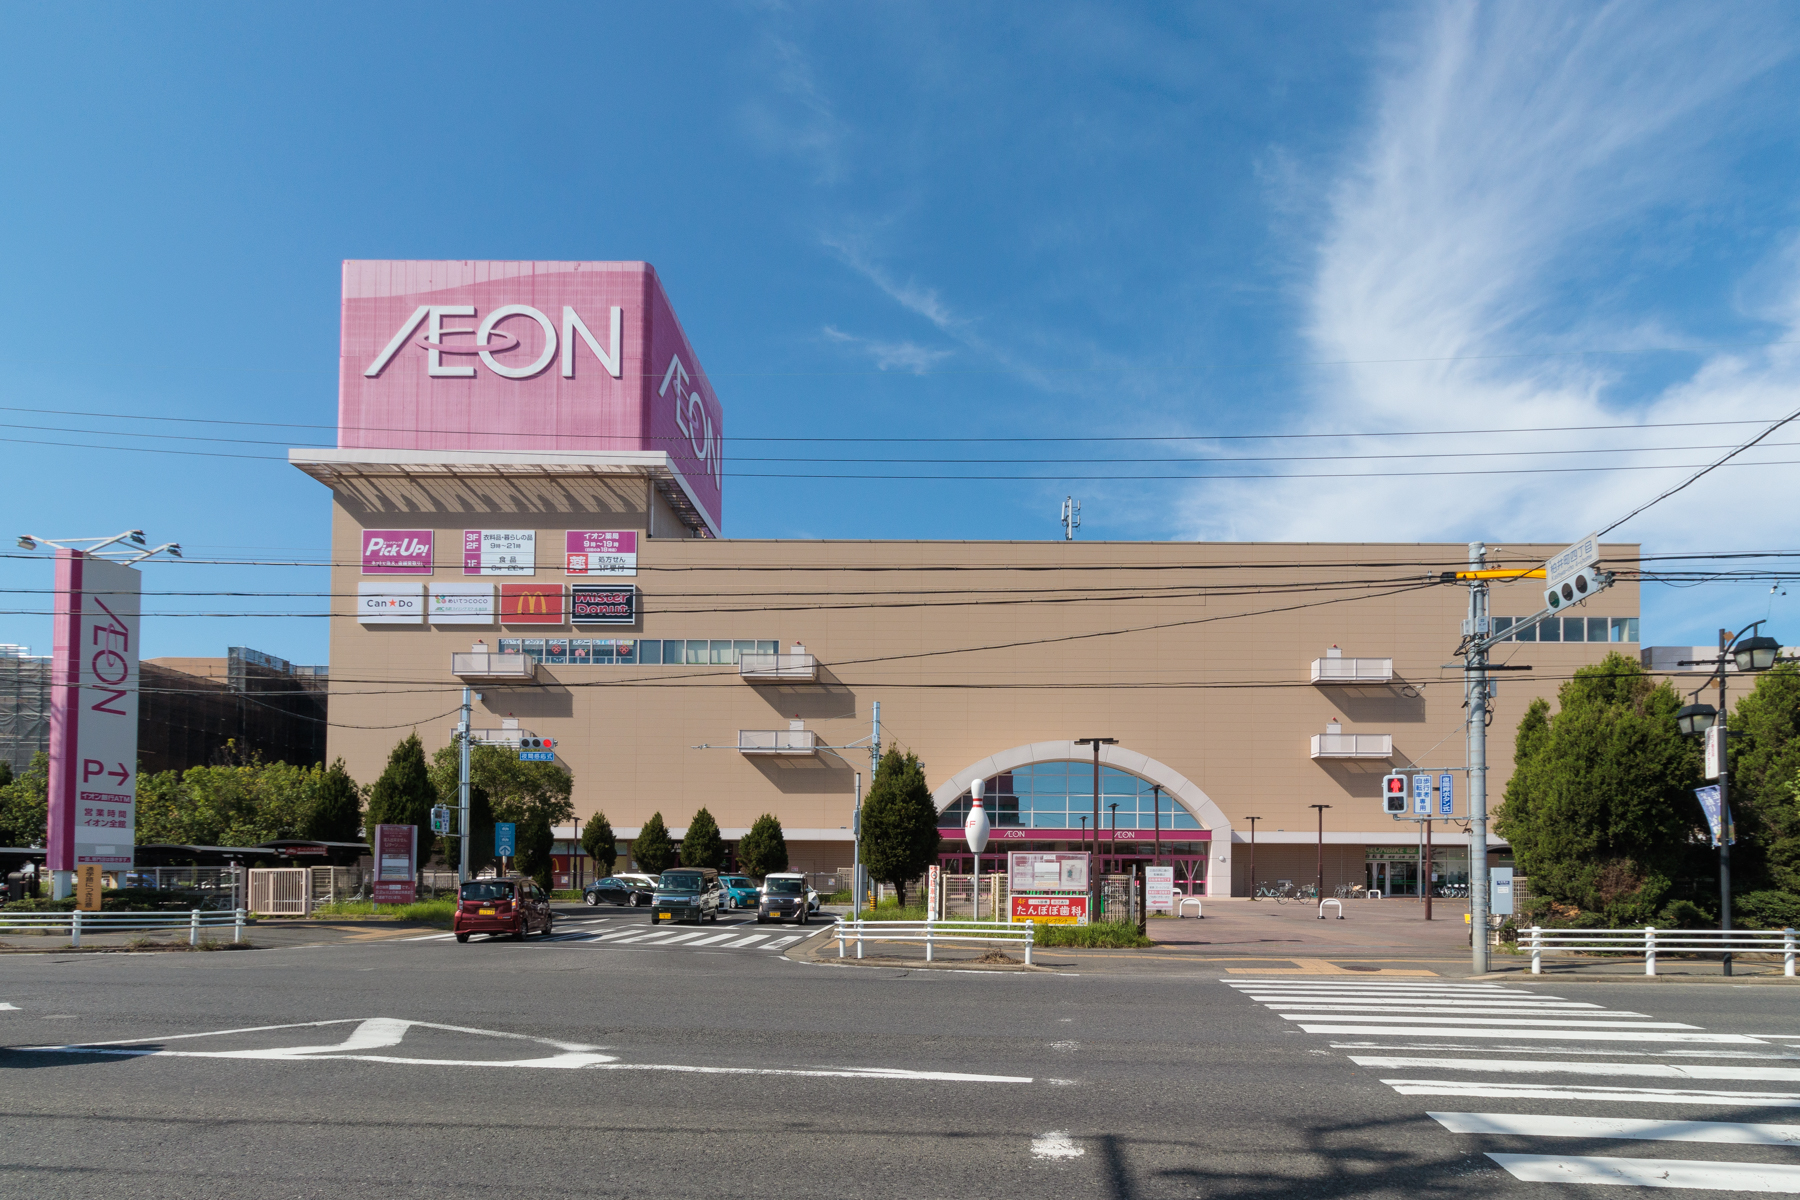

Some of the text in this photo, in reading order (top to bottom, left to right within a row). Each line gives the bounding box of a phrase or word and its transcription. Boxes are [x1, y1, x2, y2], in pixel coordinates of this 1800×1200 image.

[466, 533, 479, 541] 3F
[583, 532, 619, 540] イオン薬局
[466, 542, 479, 550] 2F
[569, 555, 586, 572] 薬
[575, 603, 630, 615] Donut
[83, 758, 104, 783] P
[84, 808, 127, 818] 営業時間
[84, 819, 127, 828] イオン全館
[84, 866, 95, 908] 通学路につき注意
[1017, 905, 1082, 916] たんぽぽ歯科
